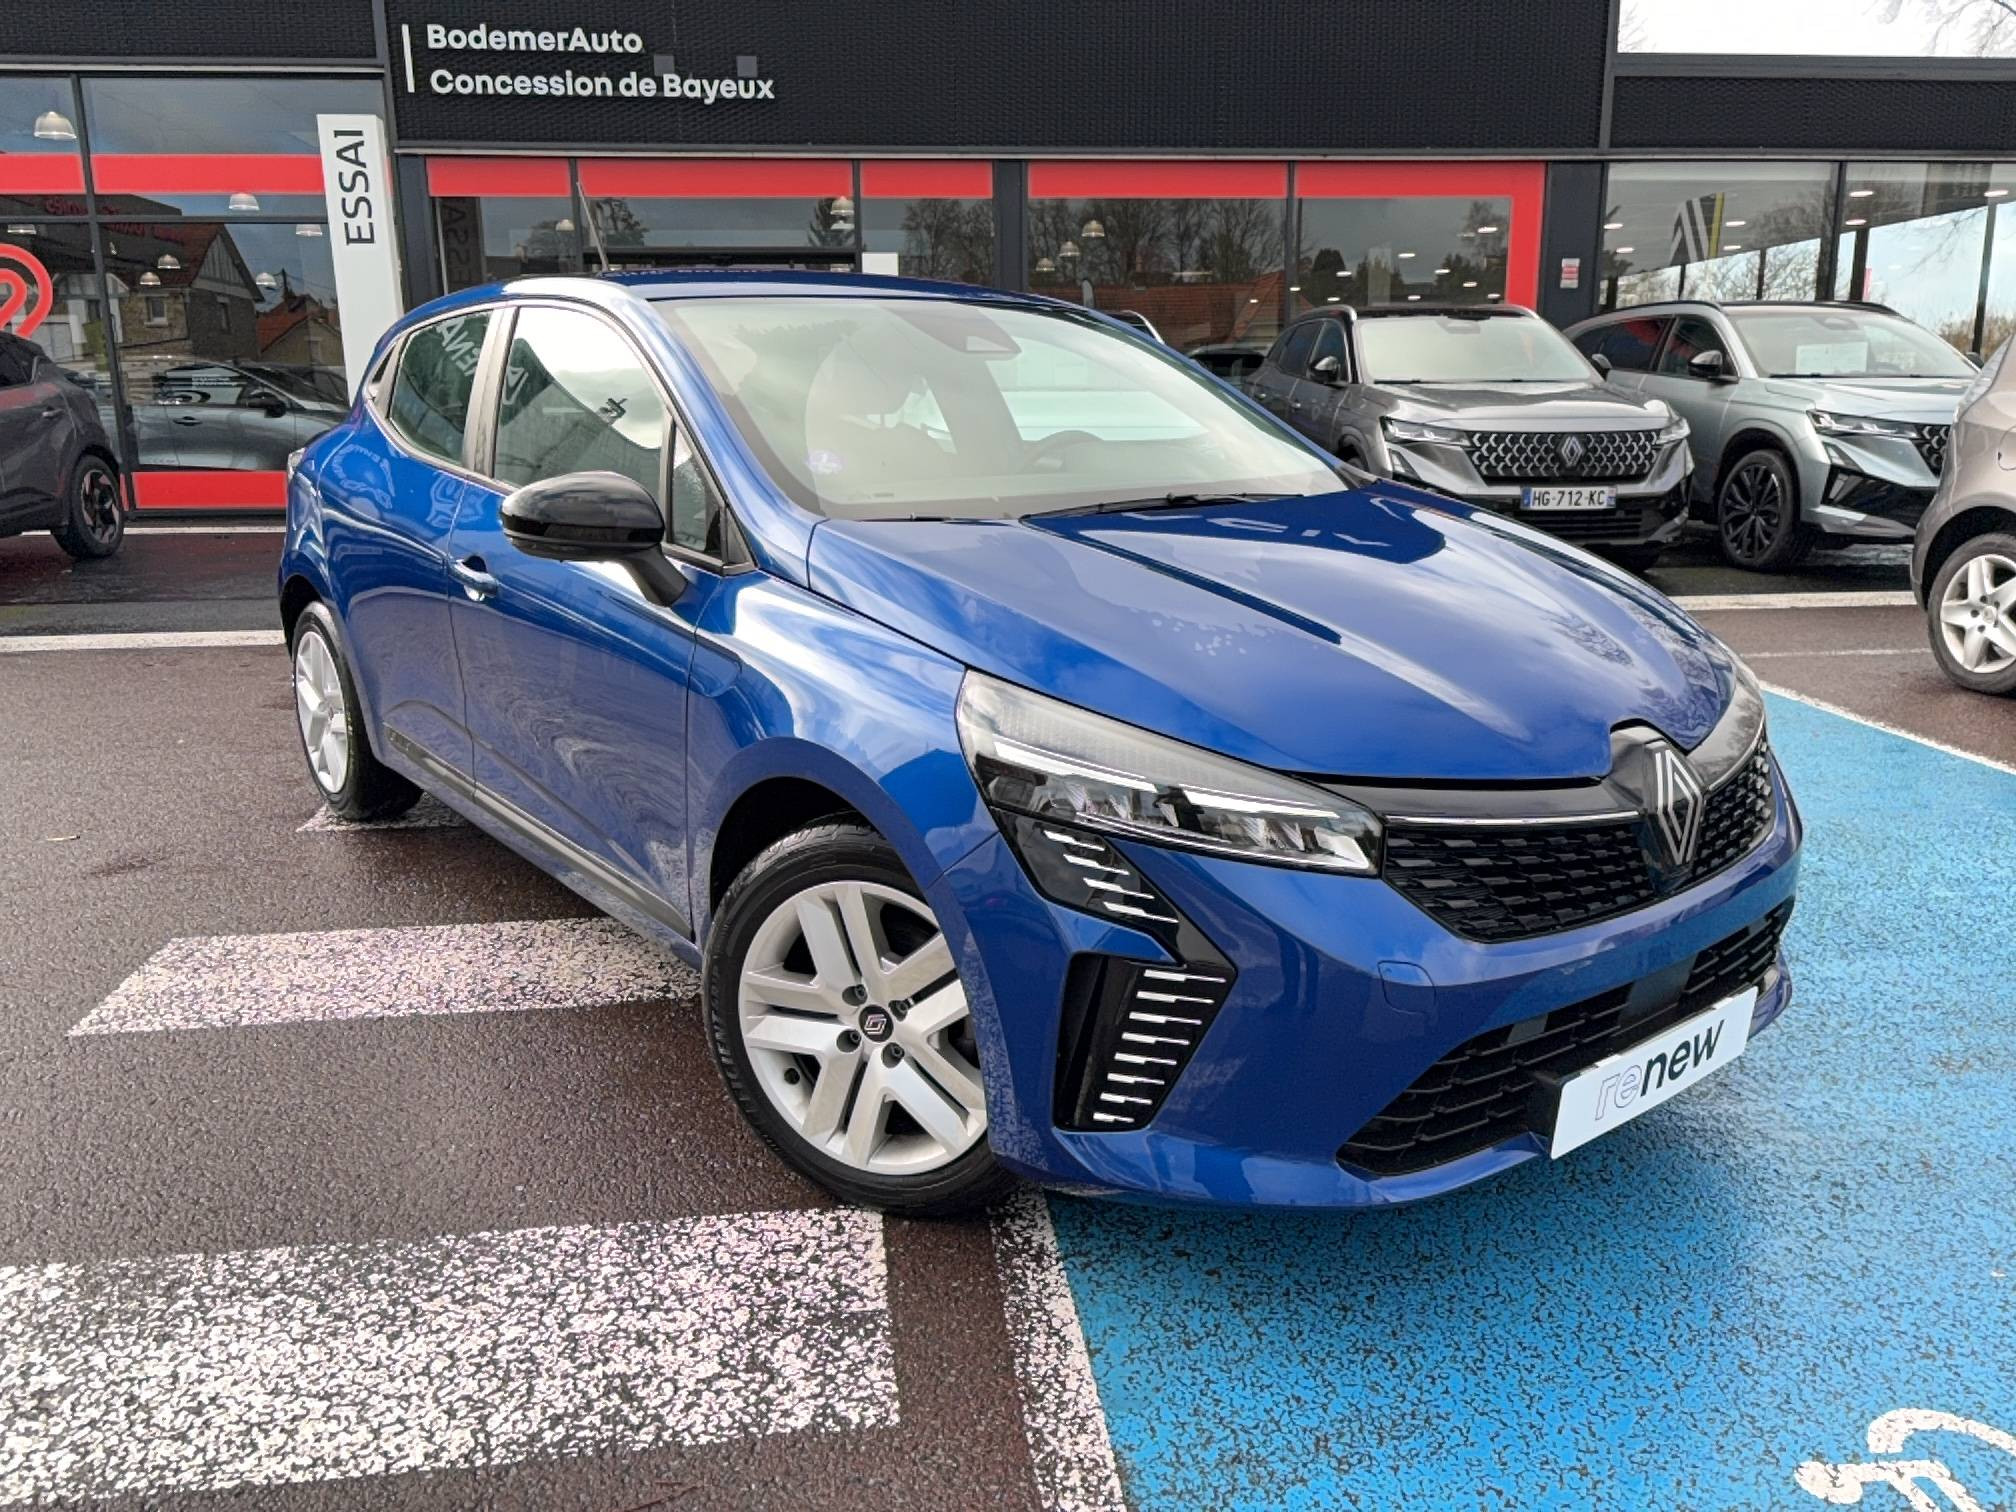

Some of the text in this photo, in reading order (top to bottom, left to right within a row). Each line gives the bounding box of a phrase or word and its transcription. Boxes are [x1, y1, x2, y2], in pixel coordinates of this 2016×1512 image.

[426, 23, 643, 53] BodemerAuto
[430, 69, 775, 105] Concession de Bayeux
[333, 129, 375, 245] ESSAI
[1532, 490, 1606, 507] HG-712-KC
[1594, 1019, 1726, 1121] renew
